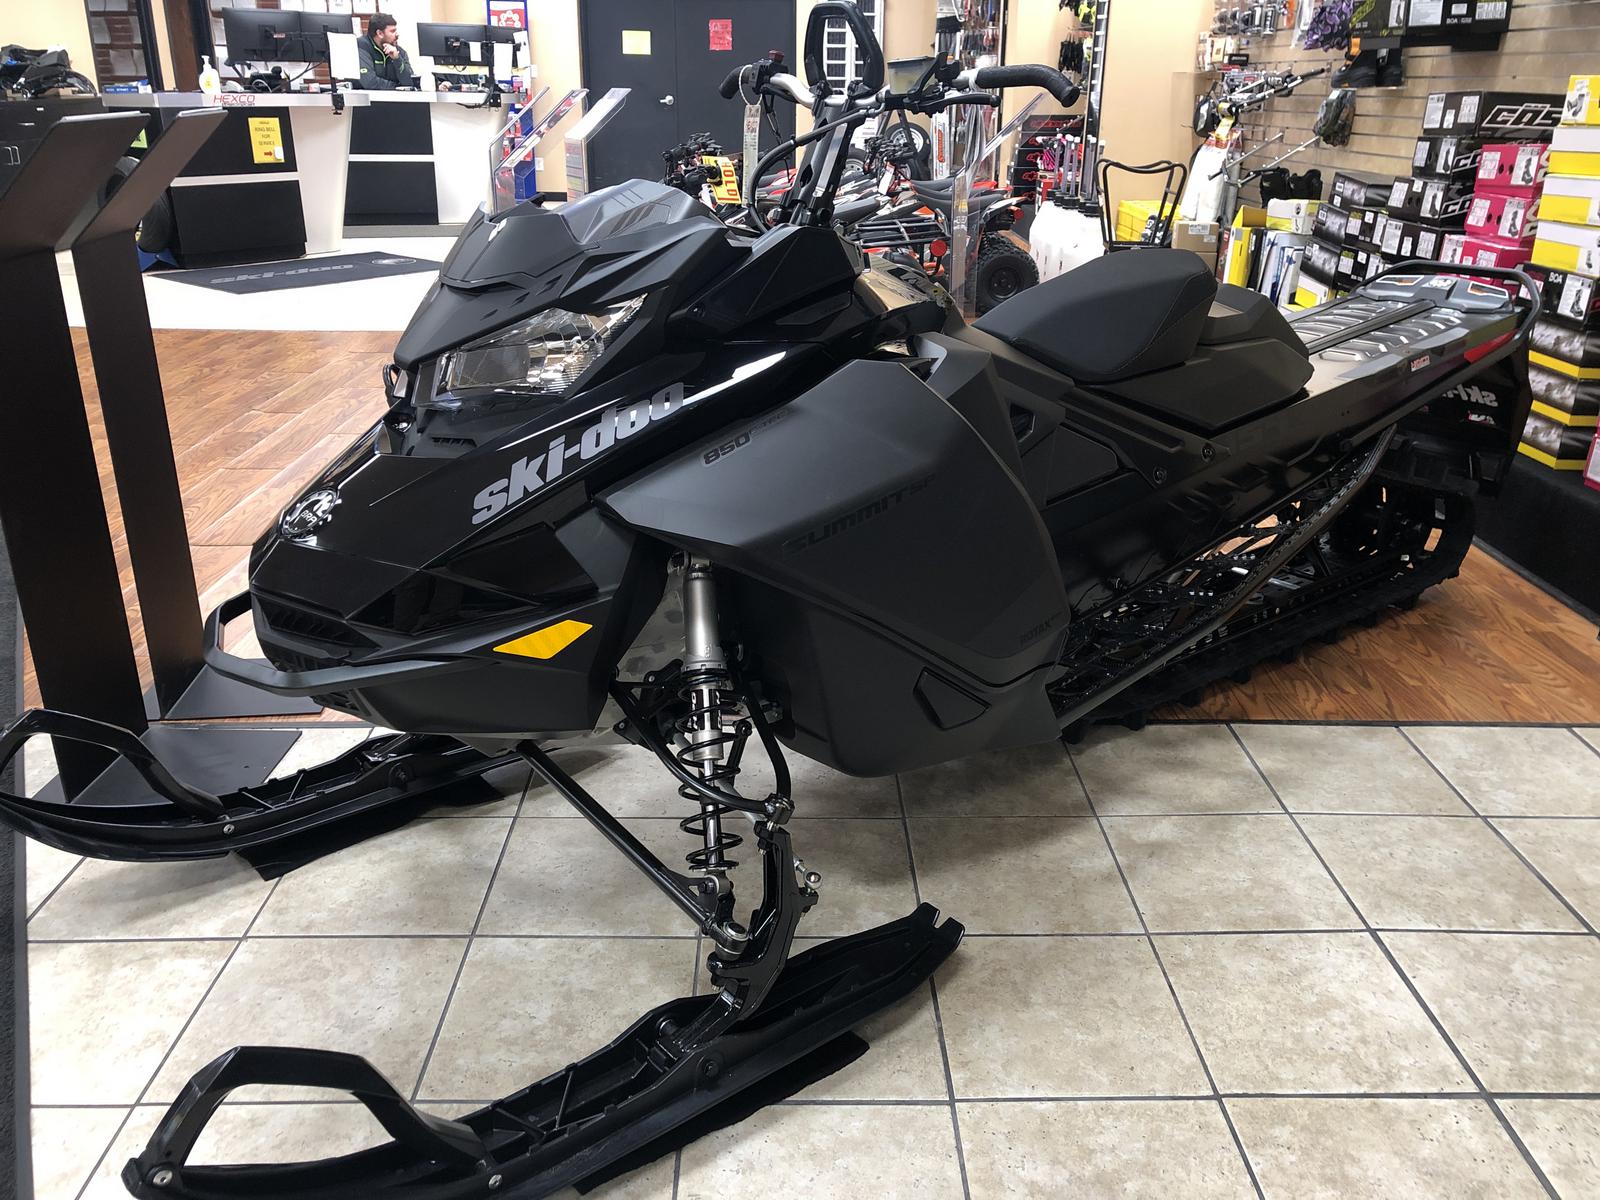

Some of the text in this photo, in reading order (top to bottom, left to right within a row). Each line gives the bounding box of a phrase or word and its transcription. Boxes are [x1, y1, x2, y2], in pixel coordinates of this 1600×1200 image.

[213, 94, 256, 104] HEXCO
[721, 160, 738, 196] HOLD
[209, 264, 354, 284] ski-doo
[471, 382, 685, 525] ski-doo
[703, 431, 751, 465] 850
[782, 486, 909, 557] SUMMIT
